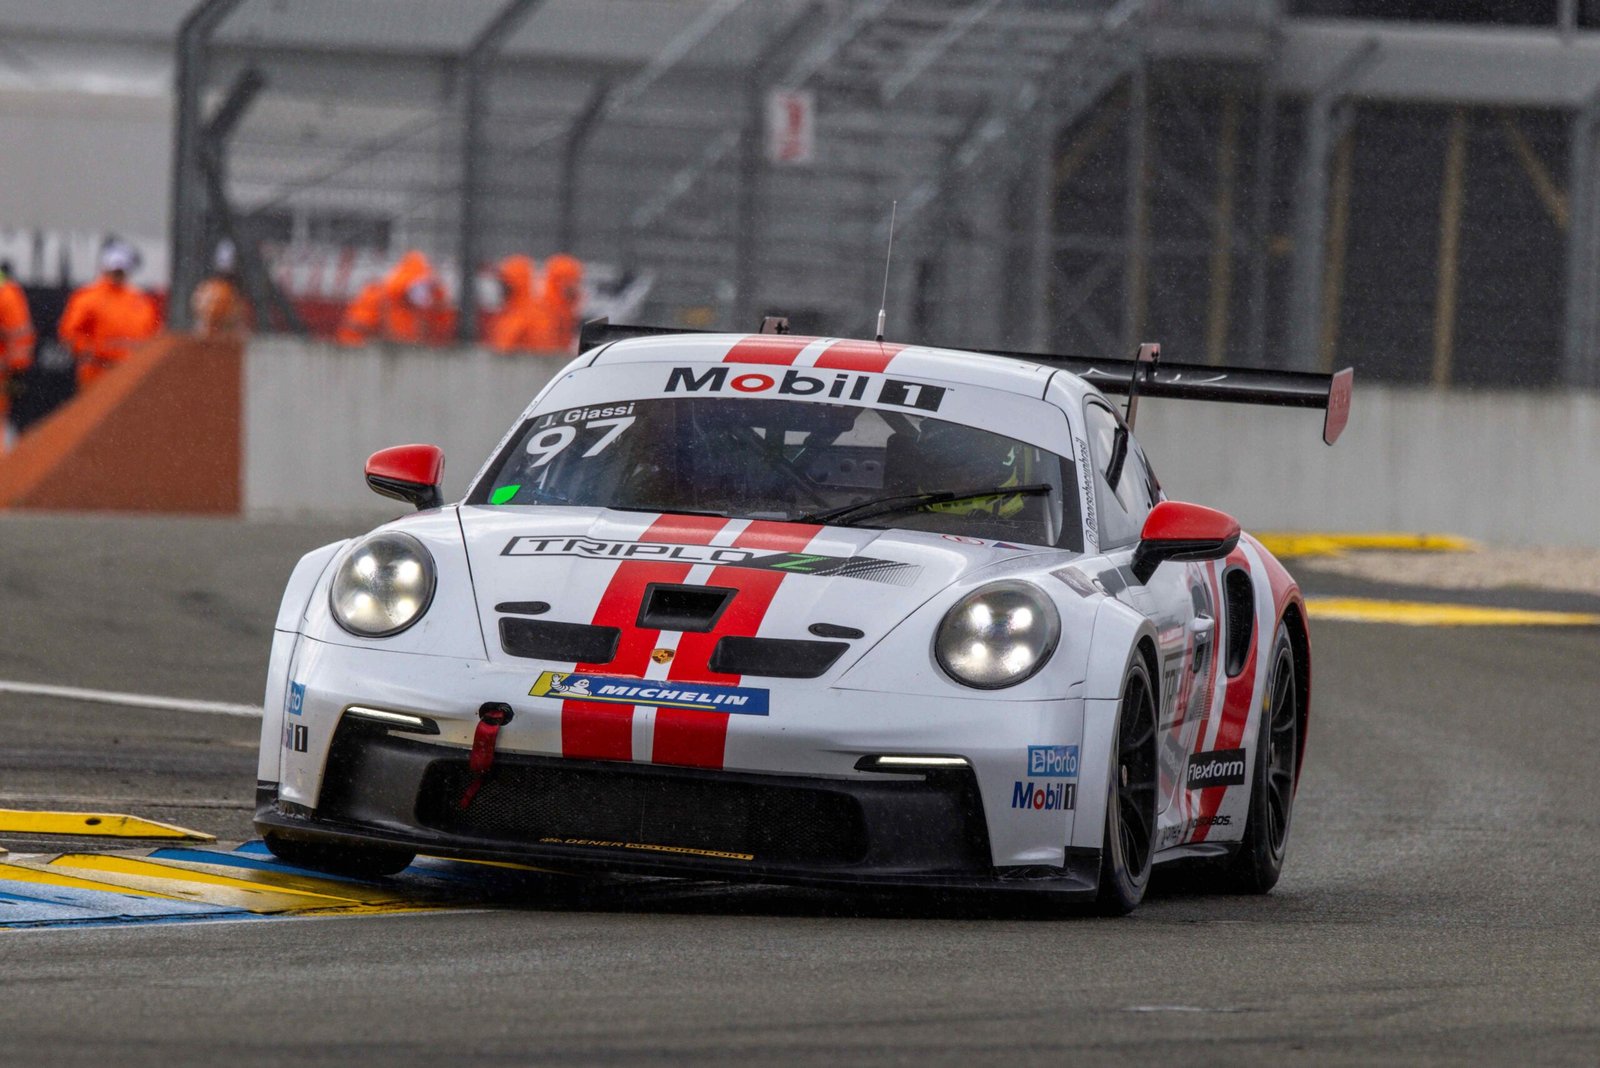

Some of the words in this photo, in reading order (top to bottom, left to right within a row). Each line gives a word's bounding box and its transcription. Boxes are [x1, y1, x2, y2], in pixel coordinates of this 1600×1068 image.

[664, 367, 870, 401] Mobil
[539, 414, 557, 429] J.
[563, 402, 636, 423] Giassi
[526, 416, 636, 469] 97
[528, 538, 756, 563] TRIPLO
[597, 684, 750, 706] MICHELIN
[1046, 749, 1077, 773] Porto
[1011, 781, 1063, 811] Mobil
